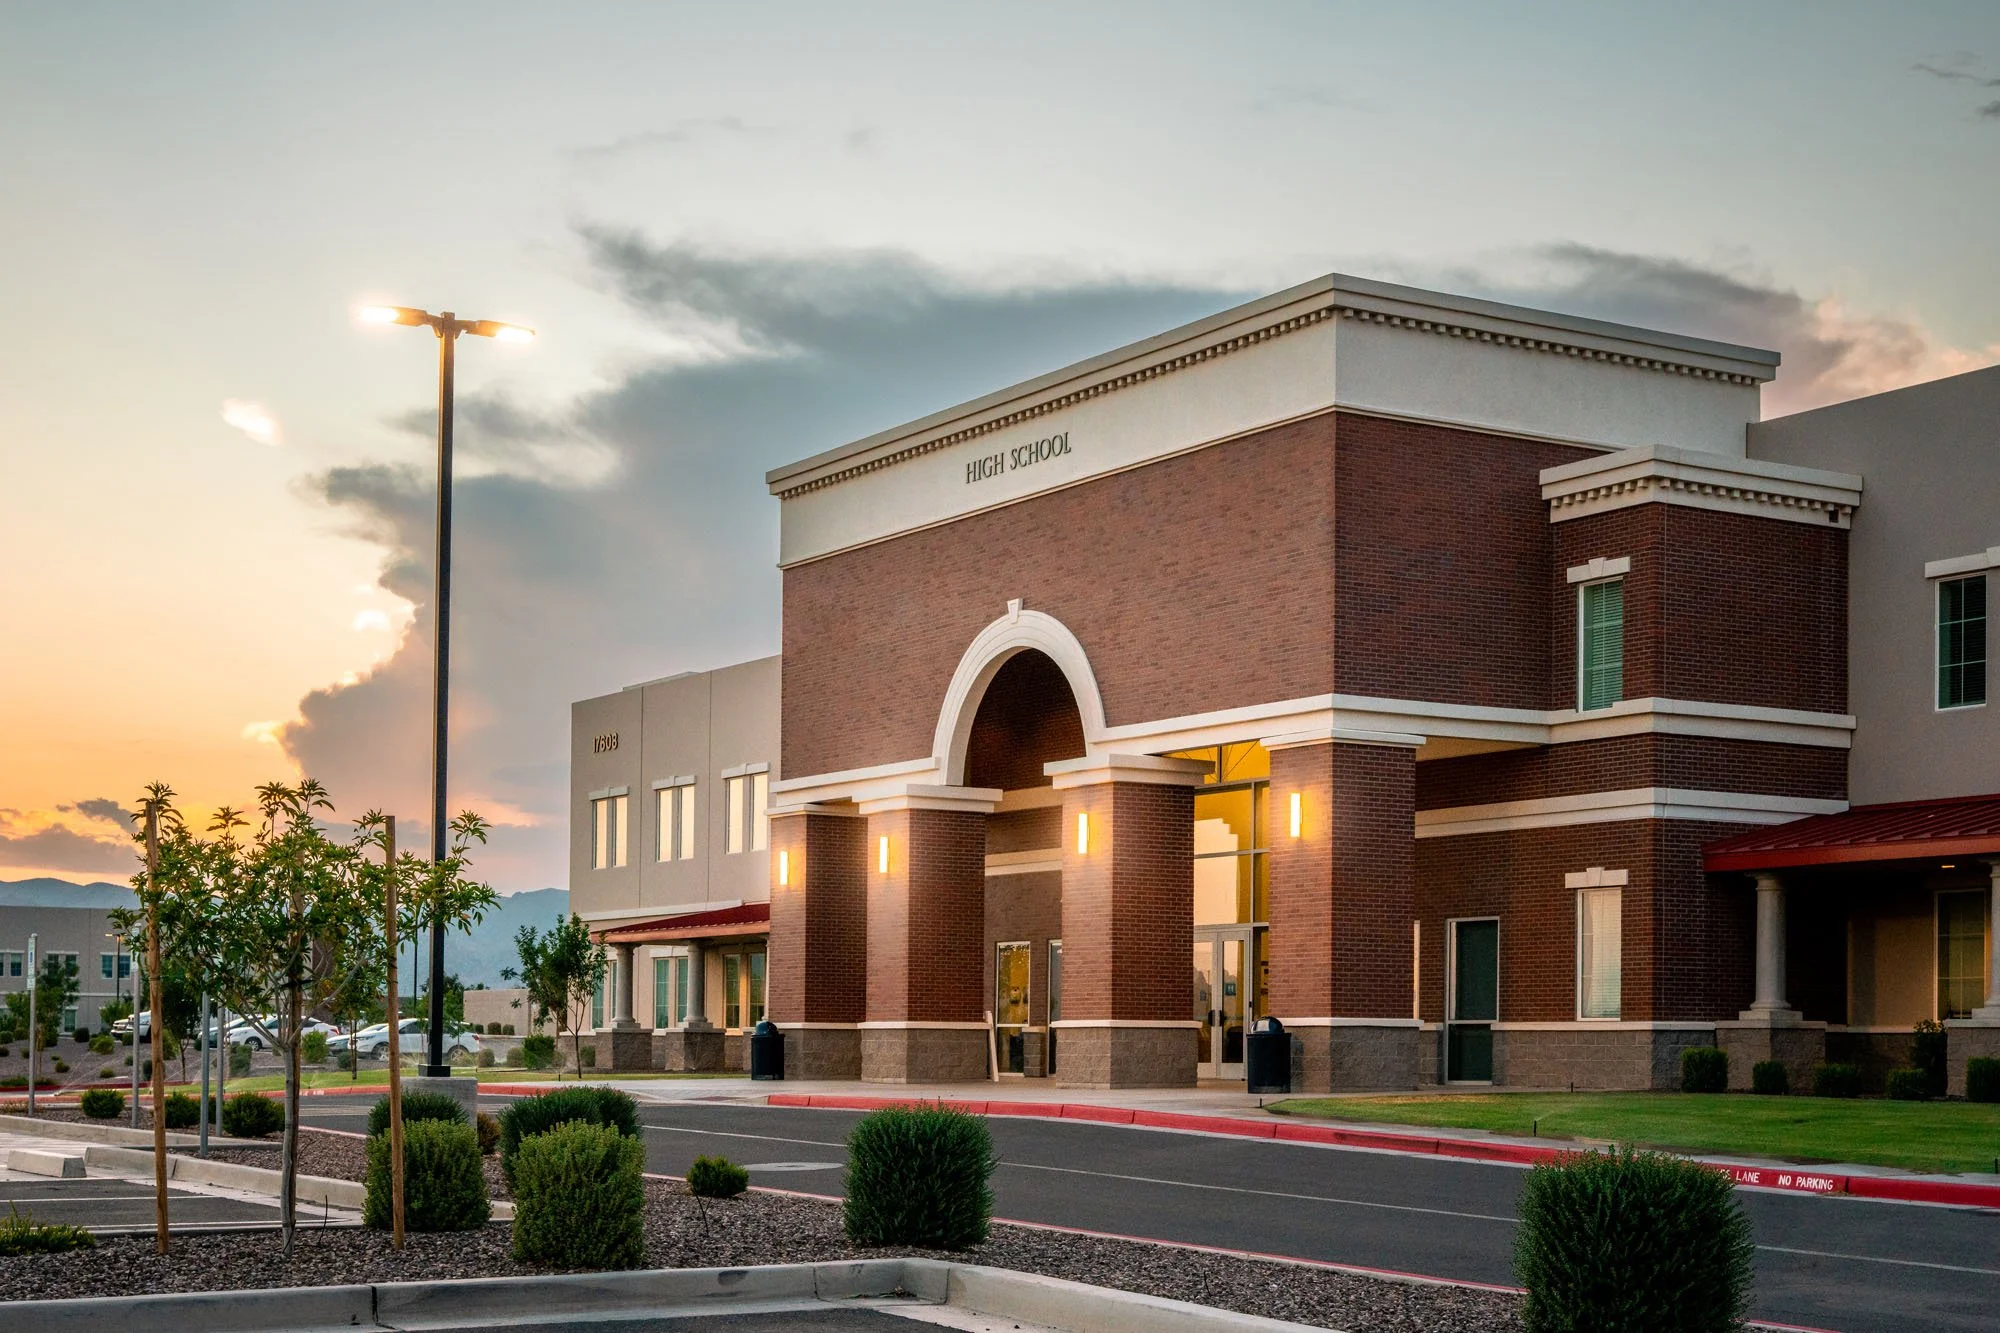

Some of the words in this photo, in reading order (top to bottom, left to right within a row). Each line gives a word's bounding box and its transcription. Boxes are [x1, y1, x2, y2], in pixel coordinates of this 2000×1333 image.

[965, 452, 1005, 484] HIGH
[1009, 431, 1072, 470] SCHOOL
[593, 732, 619, 753] 17608
[1735, 1170, 1761, 1183] LANE
[1778, 1174, 1792, 1186] NO
[1795, 1176, 1834, 1191] PARKING
